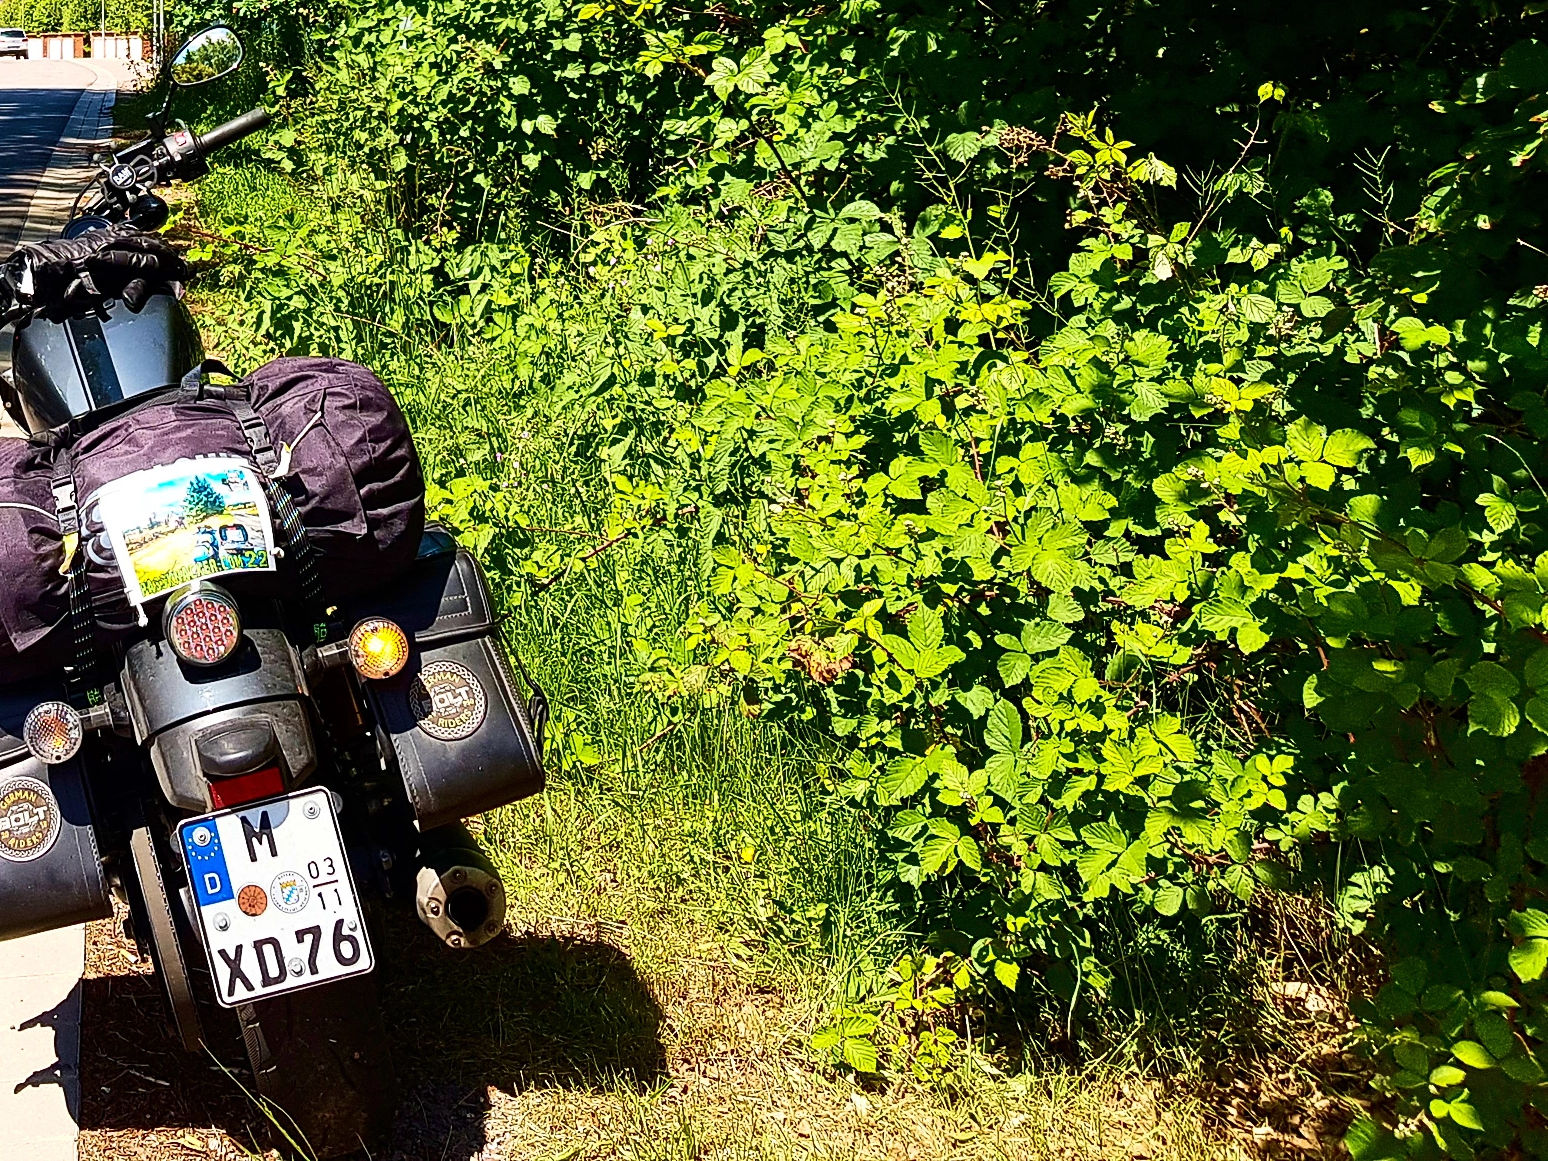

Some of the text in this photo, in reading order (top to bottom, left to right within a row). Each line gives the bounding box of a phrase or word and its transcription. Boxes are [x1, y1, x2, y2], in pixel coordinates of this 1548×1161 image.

[244, 549, 270, 569] 22
[437, 709, 472, 728] RIDERS
[0, 789, 37, 810] GERMAN
[8, 831, 44, 848] RIDERS
[239, 810, 279, 863] M
[307, 856, 336, 880] 03
[203, 872, 222, 895] D
[317, 888, 342, 911] 11
